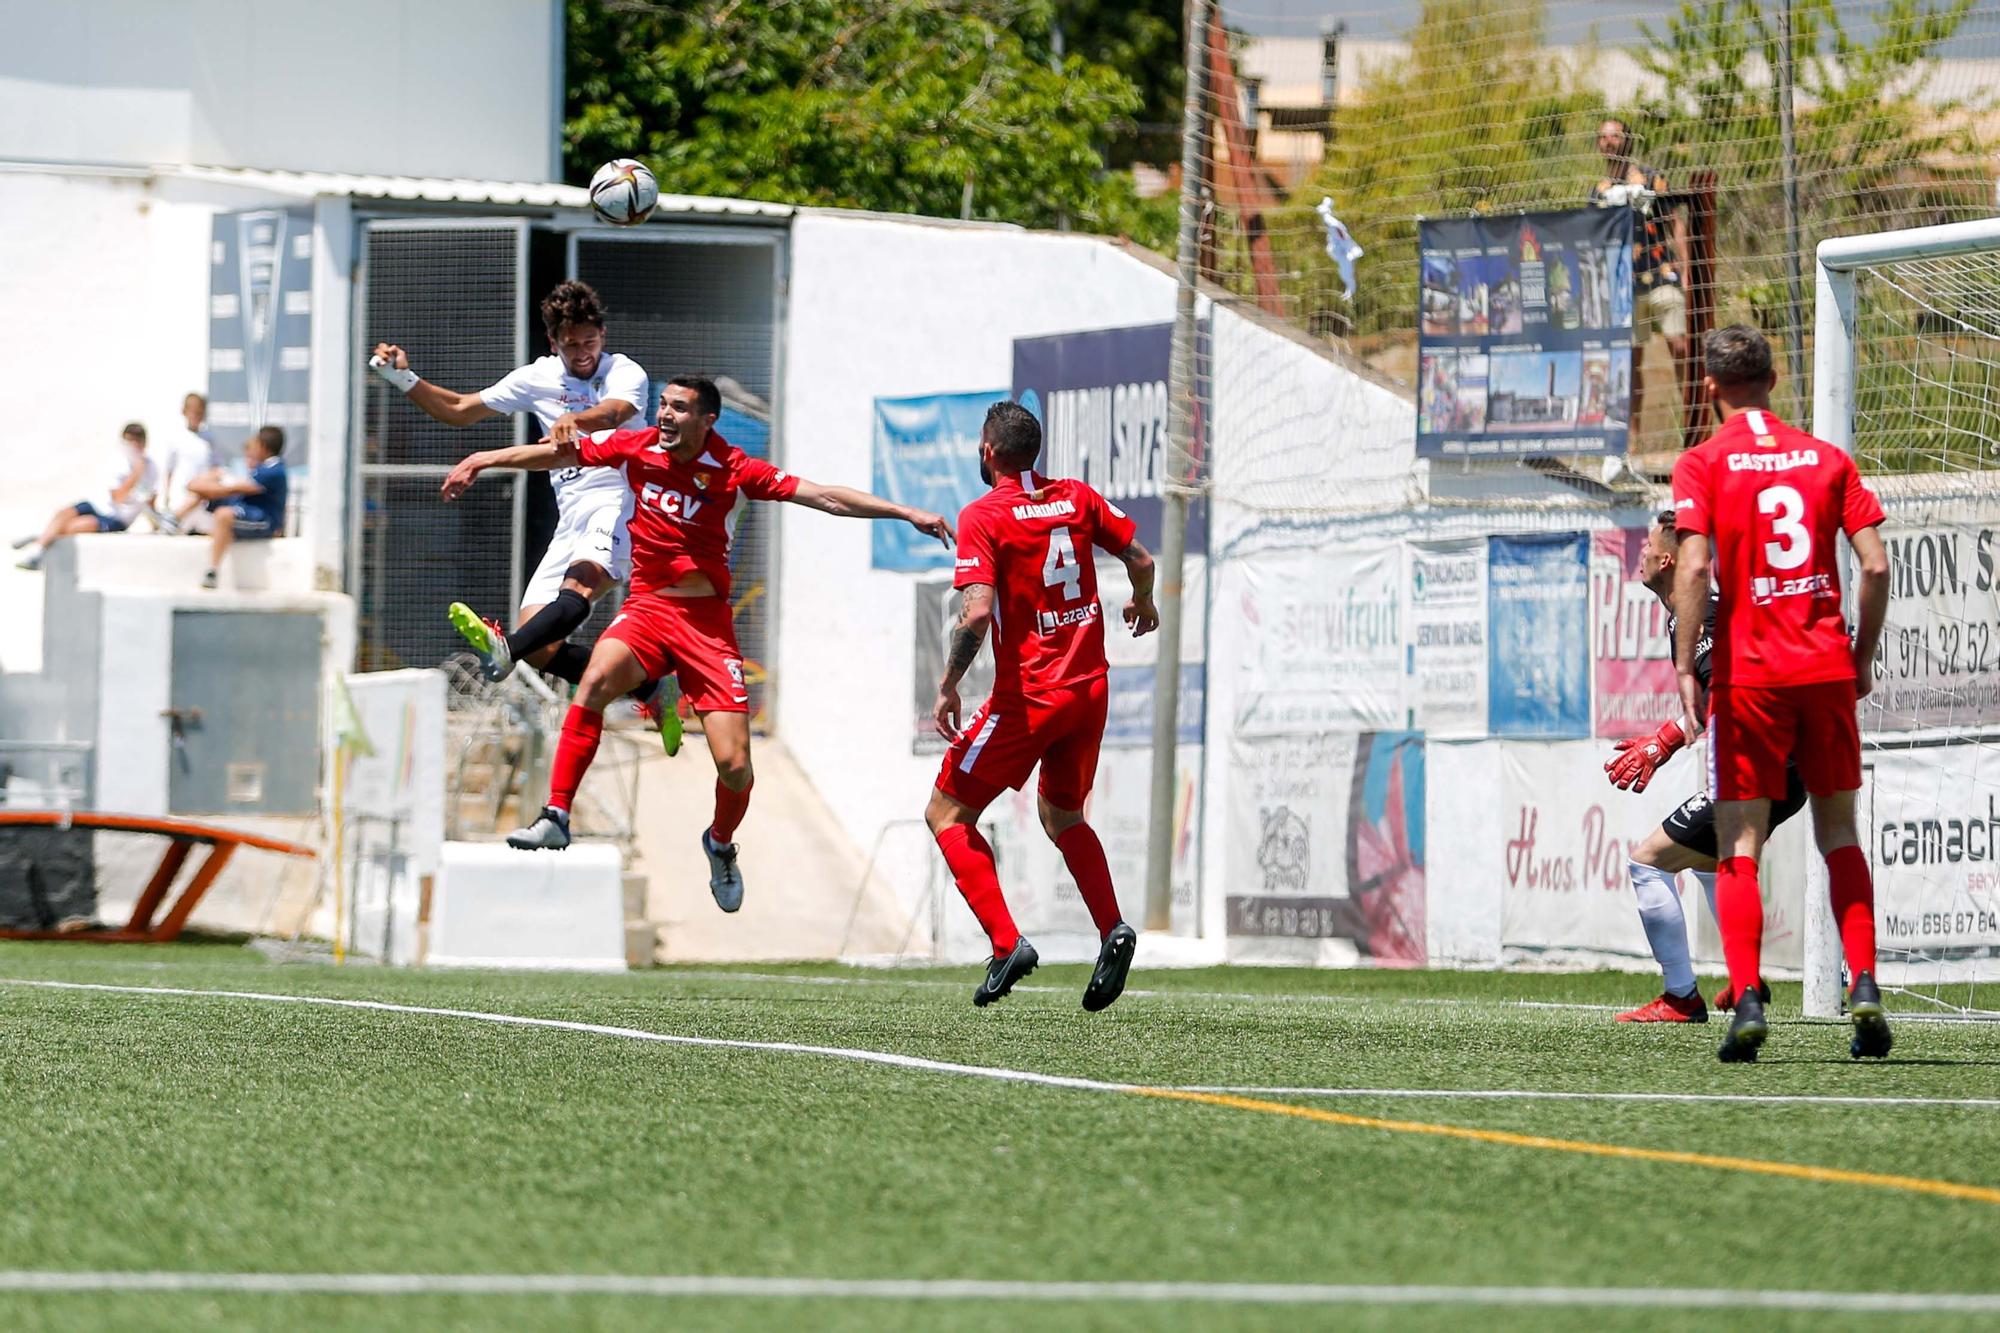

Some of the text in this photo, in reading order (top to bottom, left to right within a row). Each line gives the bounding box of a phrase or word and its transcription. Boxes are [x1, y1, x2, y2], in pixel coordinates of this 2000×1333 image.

[1727, 449, 1819, 472] CASTILLO
[1012, 500, 1076, 521] MARIMON
[1757, 485, 1811, 570] 3
[1042, 526, 1081, 601] 4
[1883, 533, 1967, 600] MON,
[1900, 628, 1929, 678] 971
[1938, 624, 1960, 675] 32
[1967, 622, 1988, 673] 52
[1886, 914, 1918, 937] Mov:
